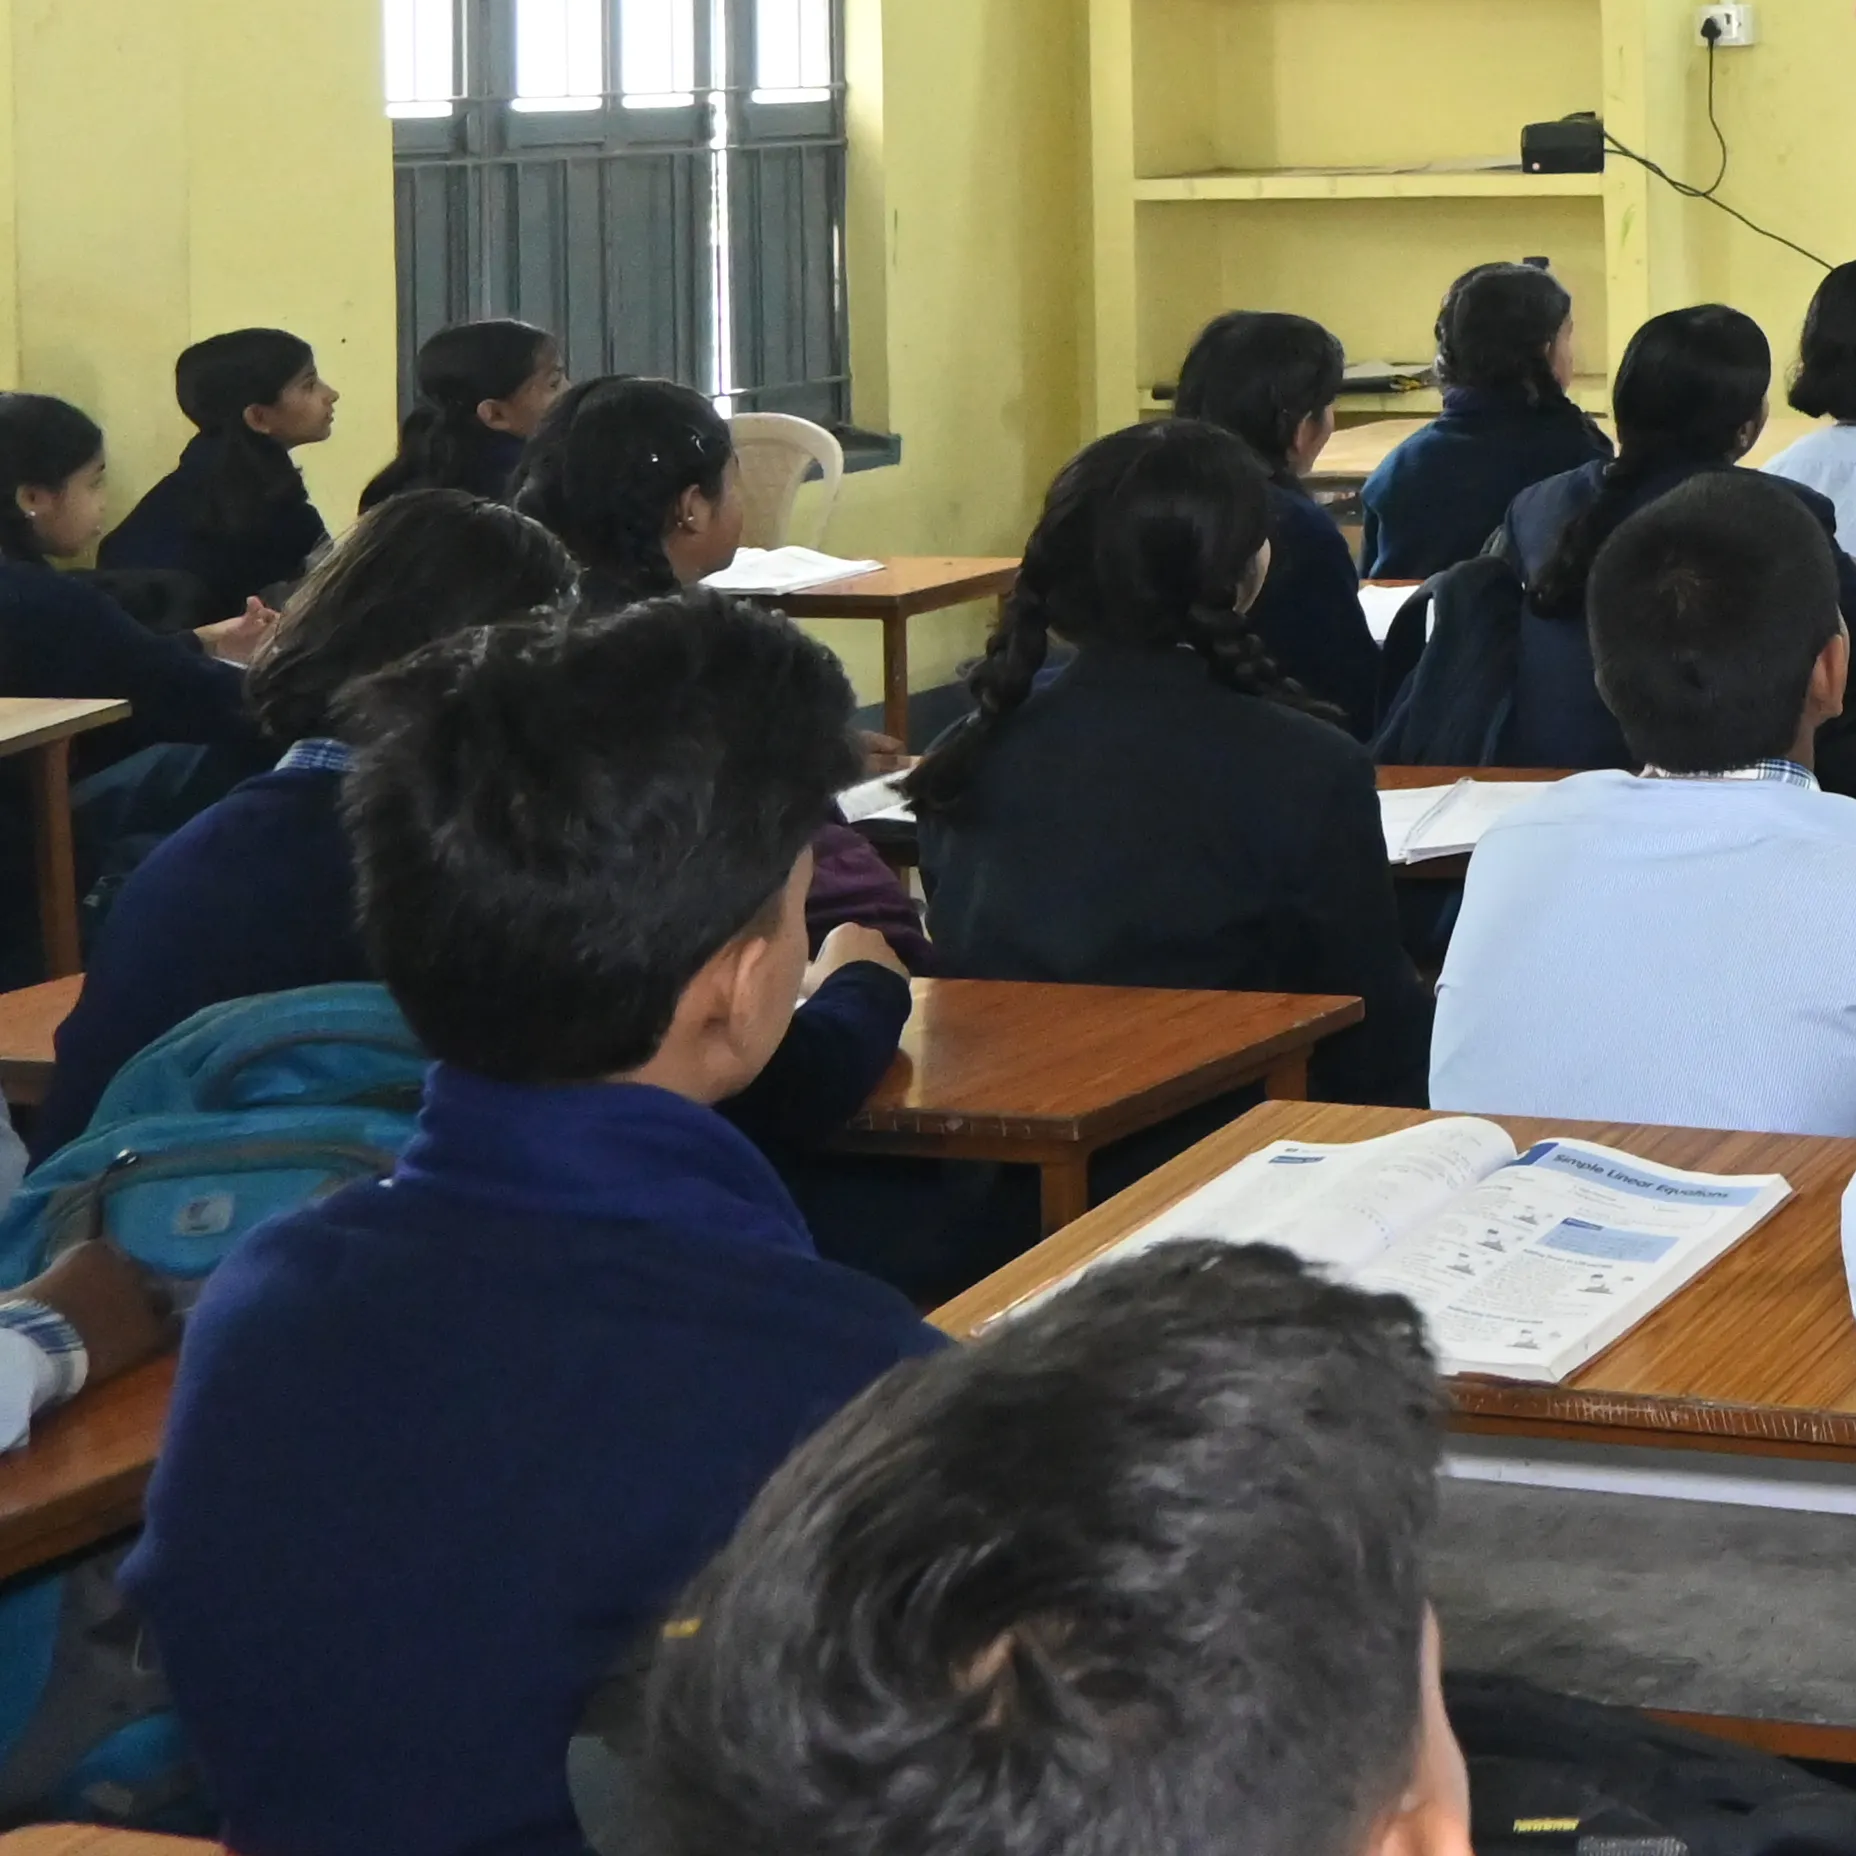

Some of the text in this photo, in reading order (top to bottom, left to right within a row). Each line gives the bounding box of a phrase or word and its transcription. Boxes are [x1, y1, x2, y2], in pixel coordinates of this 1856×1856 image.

[1553, 1154, 1728, 1198] Simple Linear Equations
